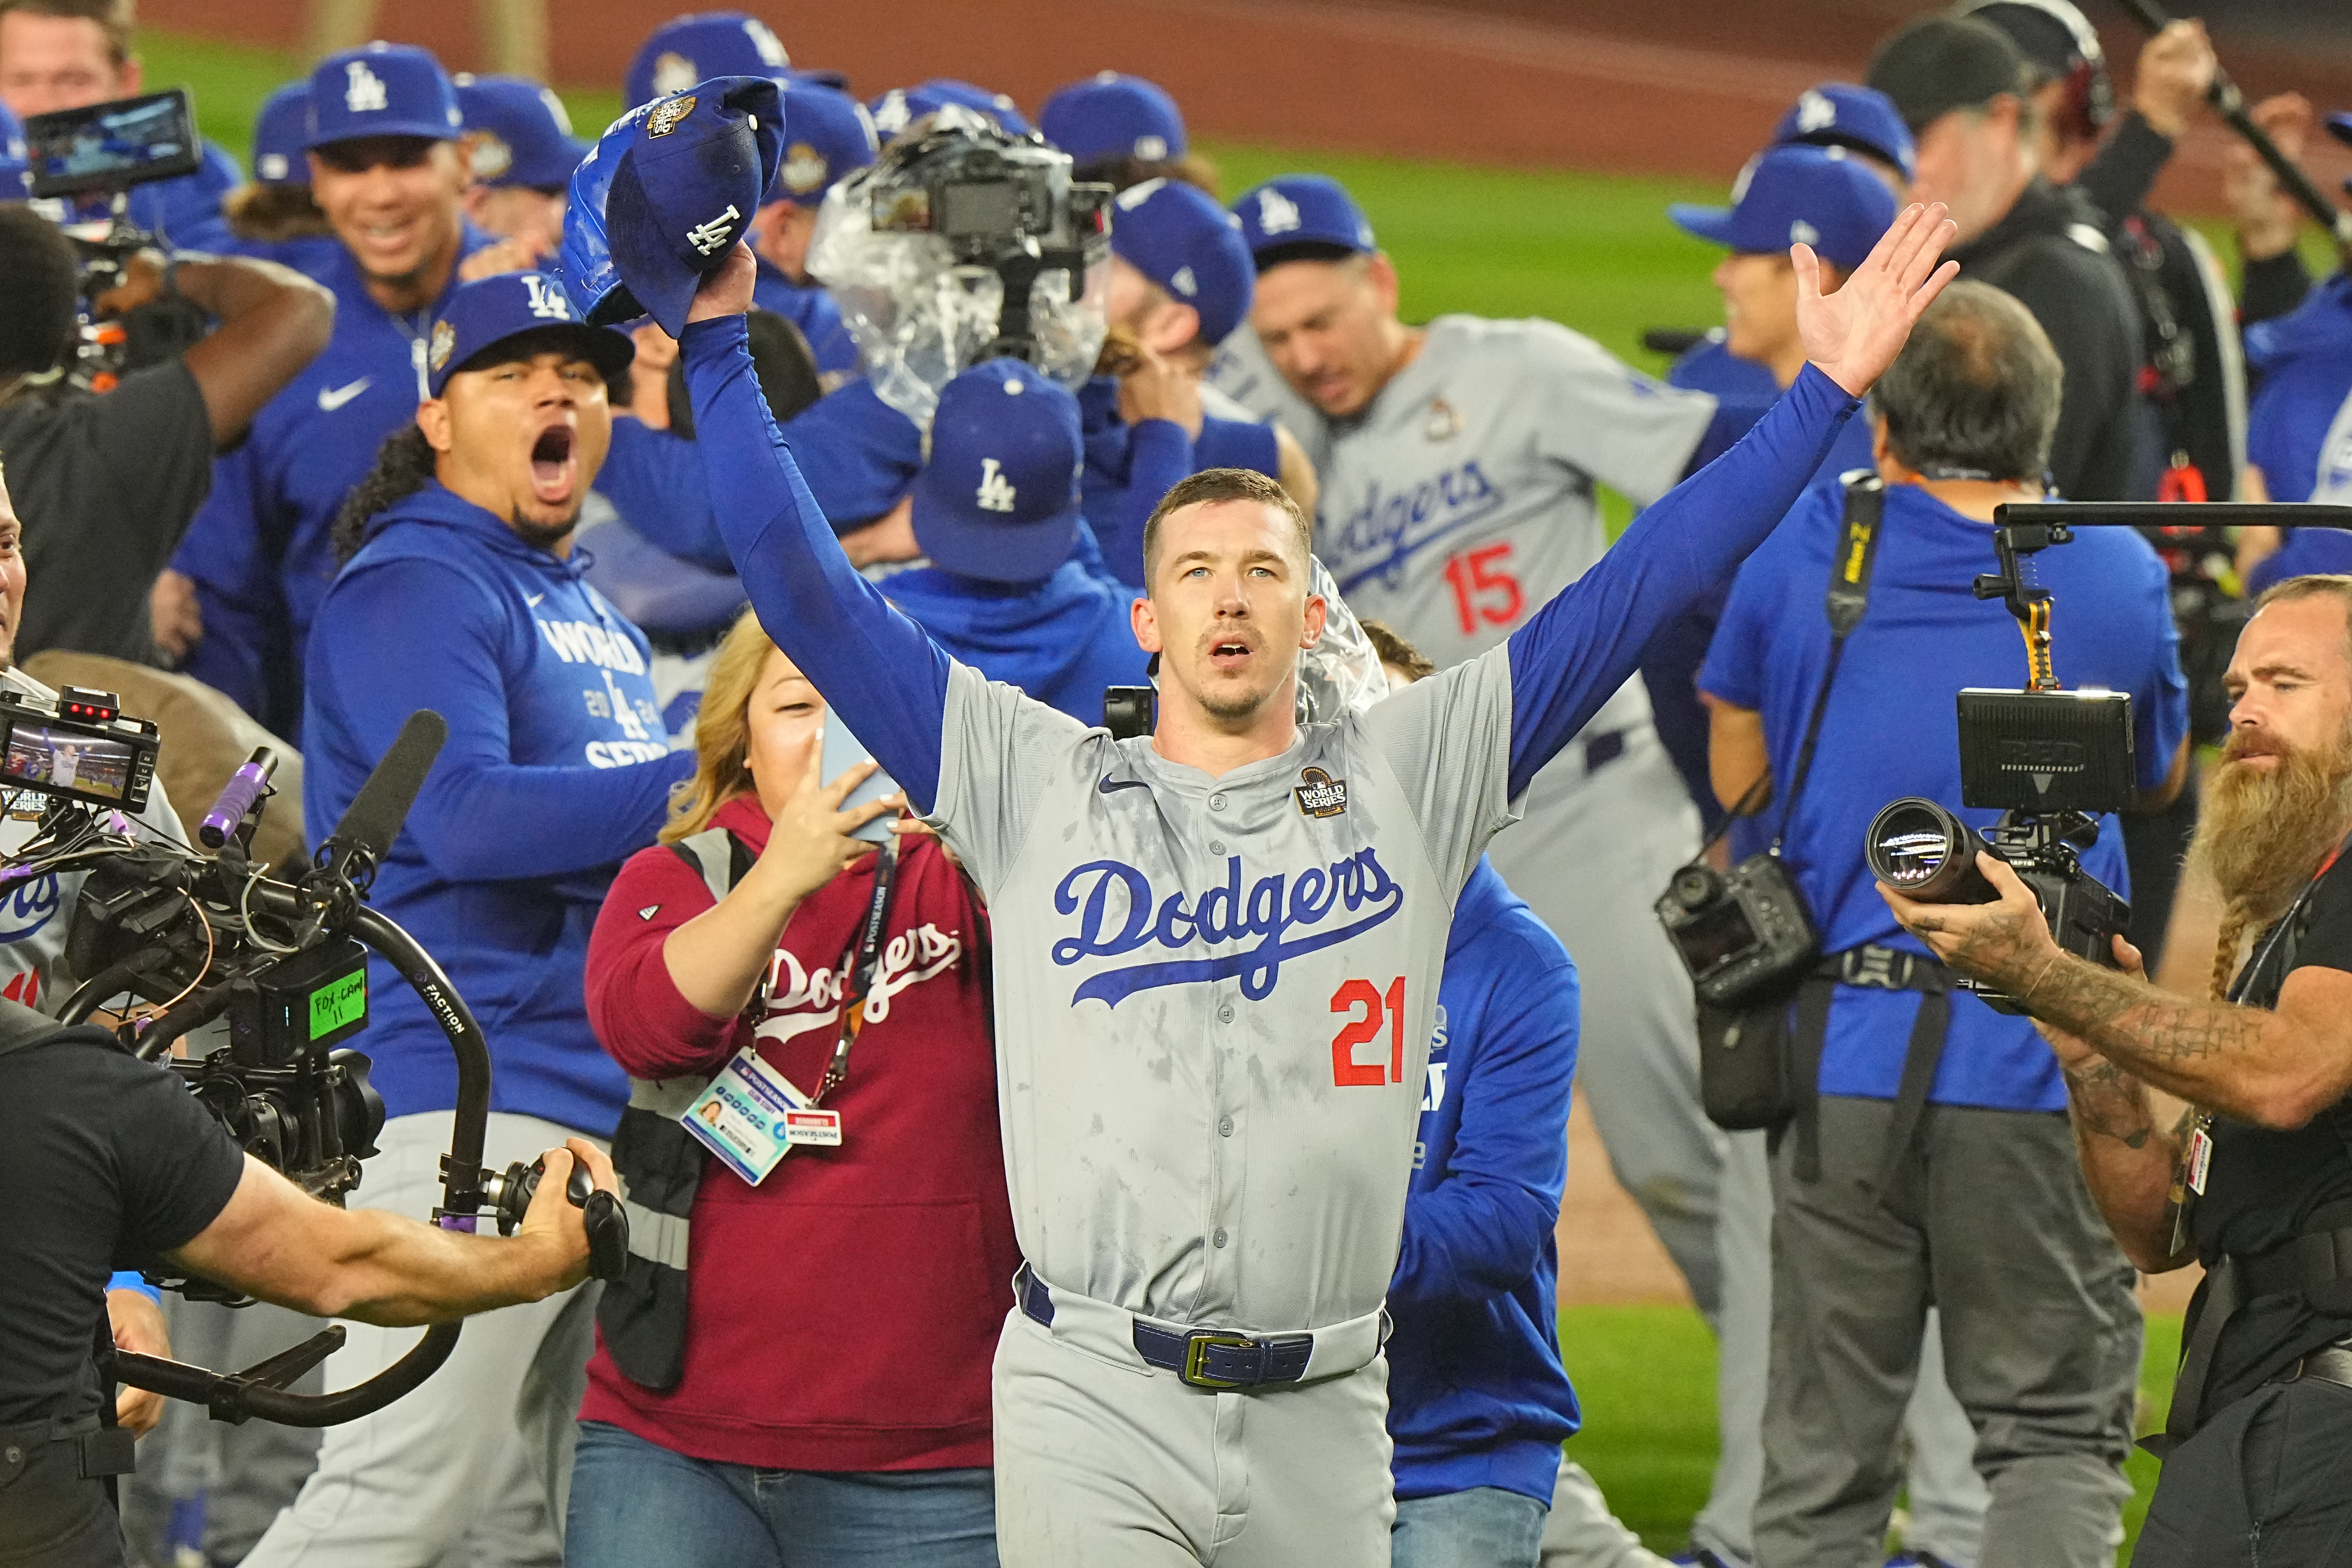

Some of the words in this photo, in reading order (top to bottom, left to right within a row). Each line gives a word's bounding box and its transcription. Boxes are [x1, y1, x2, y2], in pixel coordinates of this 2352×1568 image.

[686, 204, 740, 256] LA
[521, 276, 570, 320] LA
[976, 458, 1016, 512] LA
[1444, 540, 1524, 635] 15
[1299, 785, 1344, 800] WORLD
[1304, 794, 1346, 808] SERIES
[1051, 846, 1403, 1010] Dodgers
[426, 984, 465, 1033] FACTION
[1329, 975, 1406, 1087] 21
